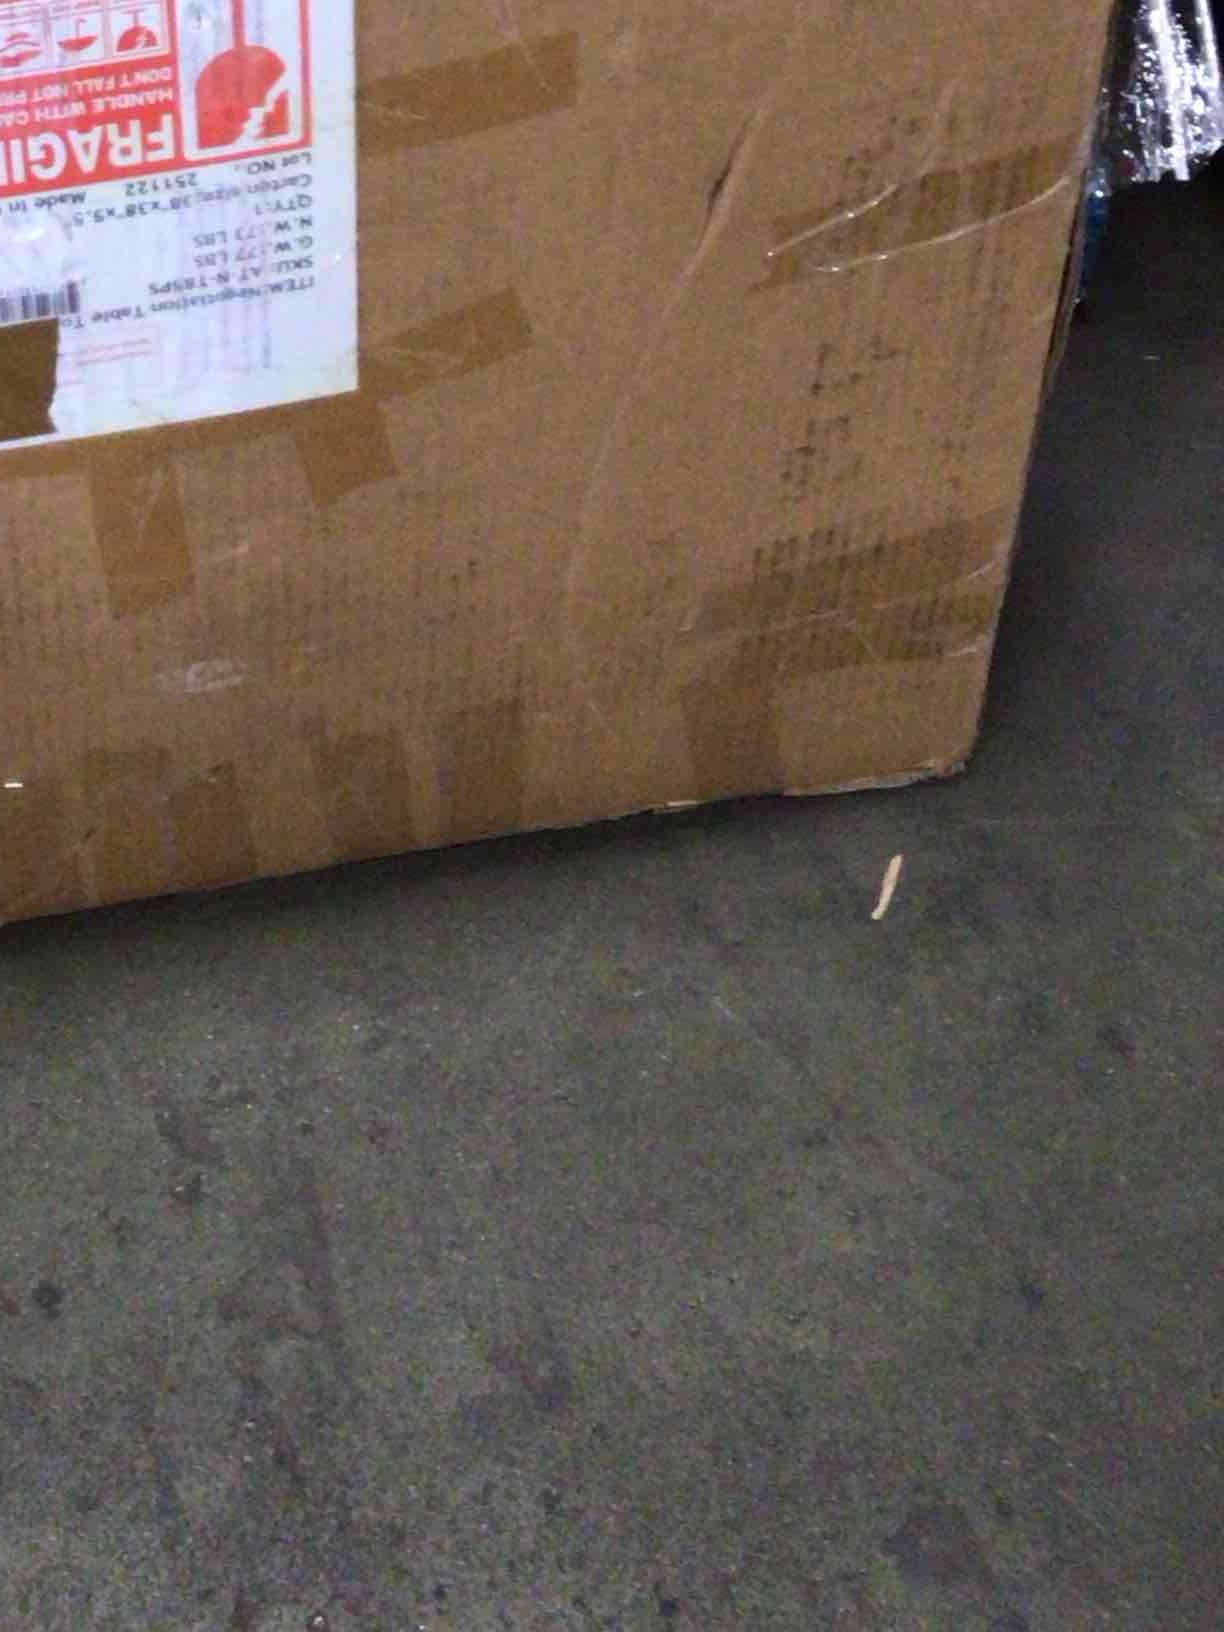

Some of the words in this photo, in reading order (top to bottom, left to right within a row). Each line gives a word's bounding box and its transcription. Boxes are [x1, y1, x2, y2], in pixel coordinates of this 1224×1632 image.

[72, 76, 116, 95] FALL
[118, 66, 173, 90] DON'T
[33, 84, 69, 102] NOT
[92, 87, 173, 108] HANDLE
[35, 101, 87, 123] WITH
[126, 172, 199, 197] 251122
[247, 173, 313, 195] Carton
[34, 191, 87, 209] Made
[192, 229, 228, 248] LBS
[194, 251, 228, 268] LBS
[91, 303, 146, 324] Table
